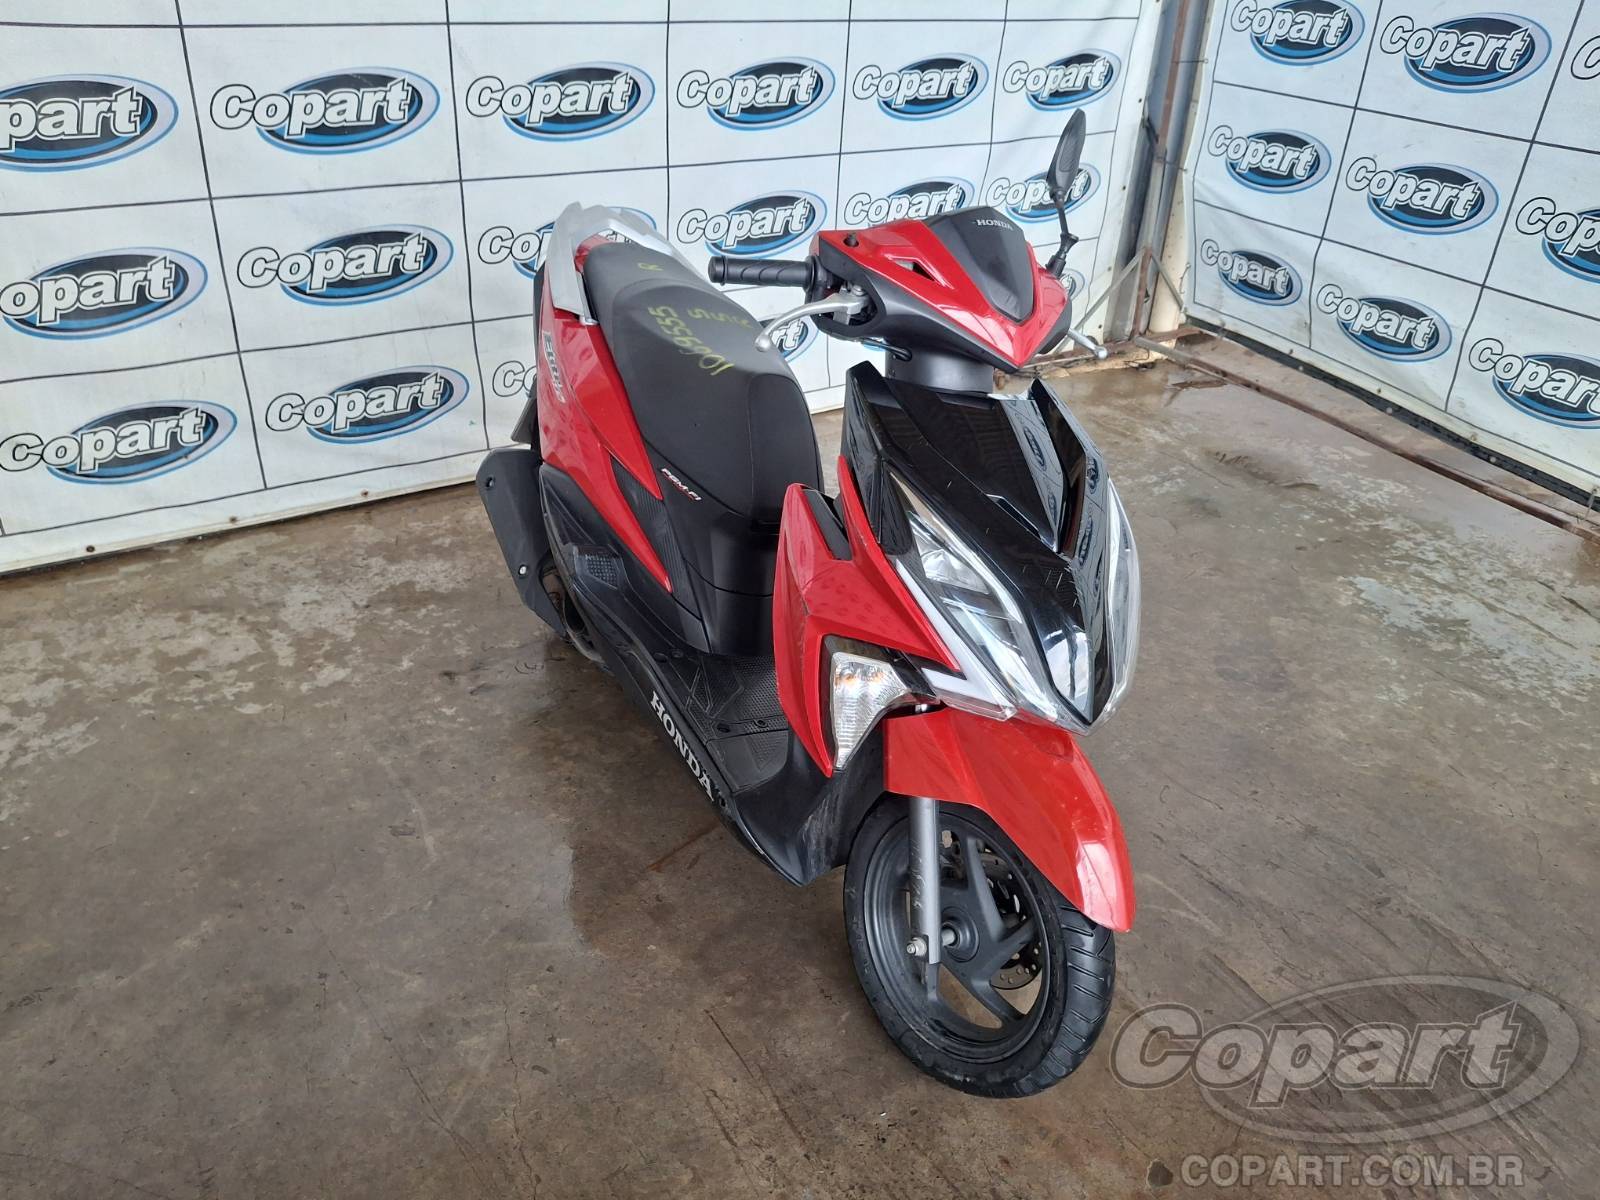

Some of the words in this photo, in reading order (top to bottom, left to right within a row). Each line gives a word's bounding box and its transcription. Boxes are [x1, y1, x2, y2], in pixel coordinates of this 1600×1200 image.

[1230, 0, 1348, 45] Copart
[1380, 16, 1530, 69] Copart
[466, 70, 633, 124] Copart
[677, 67, 815, 115] Copart
[853, 57, 975, 106] Copart
[1002, 55, 1110, 96] Copart
[210, 78, 412, 137] Copart
[1207, 125, 1318, 177] Copart
[845, 183, 967, 224] Copart
[1345, 157, 1482, 216] Copart
[677, 198, 808, 247] Copart
[976, 218, 1014, 230] HONDA
[237, 232, 426, 291] Copart
[1201, 239, 1289, 296] Copart
[1316, 284, 1437, 349] Copart
[265, 371, 445, 431] Copart
[0, 406, 206, 472] Copart
[650, 691, 714, 801] HONDA
